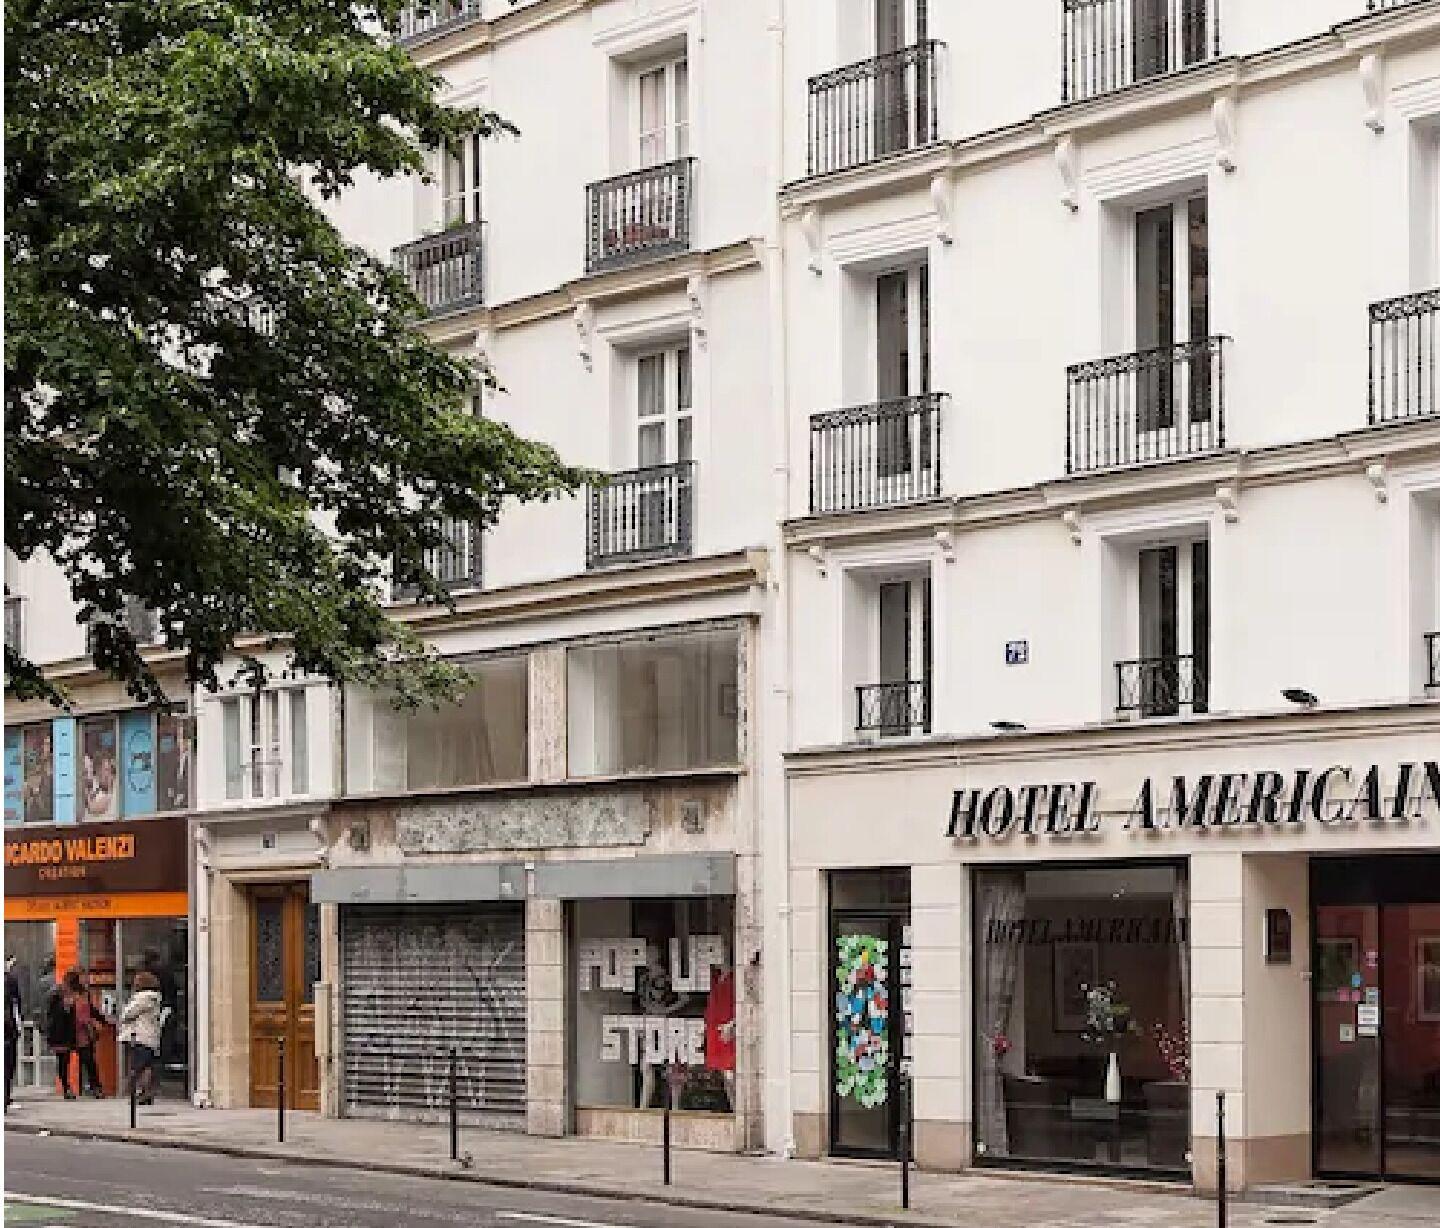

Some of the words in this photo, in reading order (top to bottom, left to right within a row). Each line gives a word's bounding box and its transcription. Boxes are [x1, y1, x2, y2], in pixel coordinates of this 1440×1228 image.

[944, 780, 1100, 840] HOTEL
[64, 833, 136, 862] VALENZI
[579, 937, 647, 991] POP
[668, 934, 723, 991] UP
[600, 1014, 706, 1066] STORE
